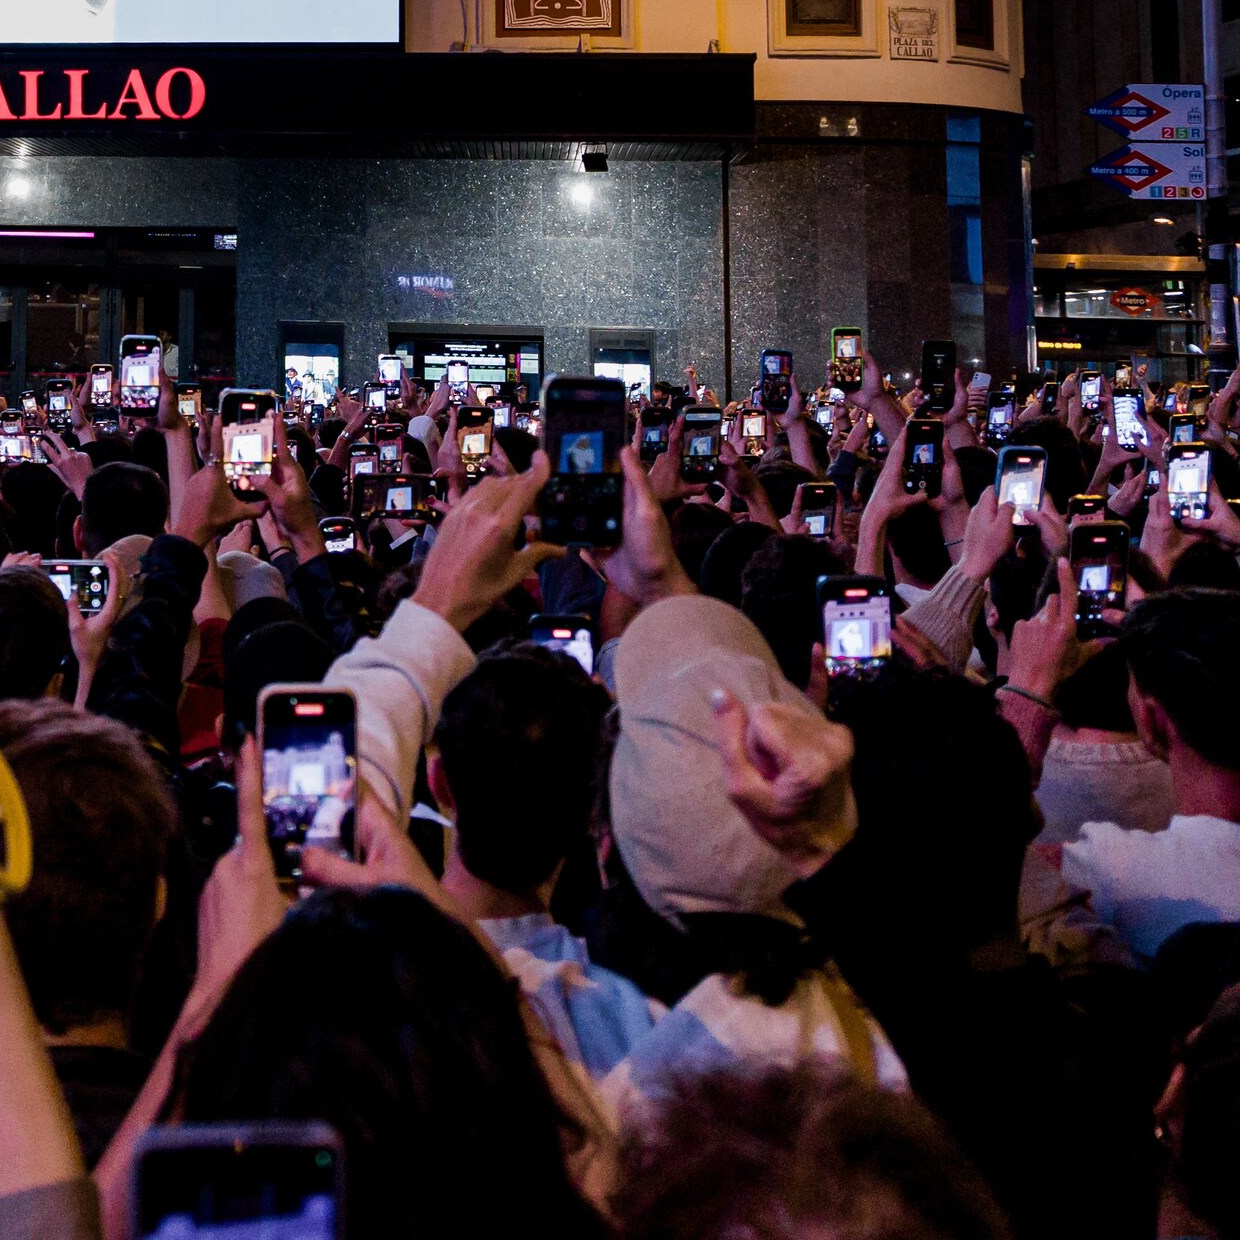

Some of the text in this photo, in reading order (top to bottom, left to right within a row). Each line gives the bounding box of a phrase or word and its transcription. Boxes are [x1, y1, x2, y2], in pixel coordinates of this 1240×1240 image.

[893, 37, 919, 46] PLAZA
[896, 46, 933, 58] CALLAO
[1162, 85, 1201, 100] Ópera
[1163, 128, 1201, 138] 2 5 R
[1183, 146, 1204, 157] Sol
[1124, 167, 1139, 175] 400
[1166, 187, 1174, 197] 2
[1180, 187, 1188, 197] 3
[1121, 296, 1146, 305] Metro
